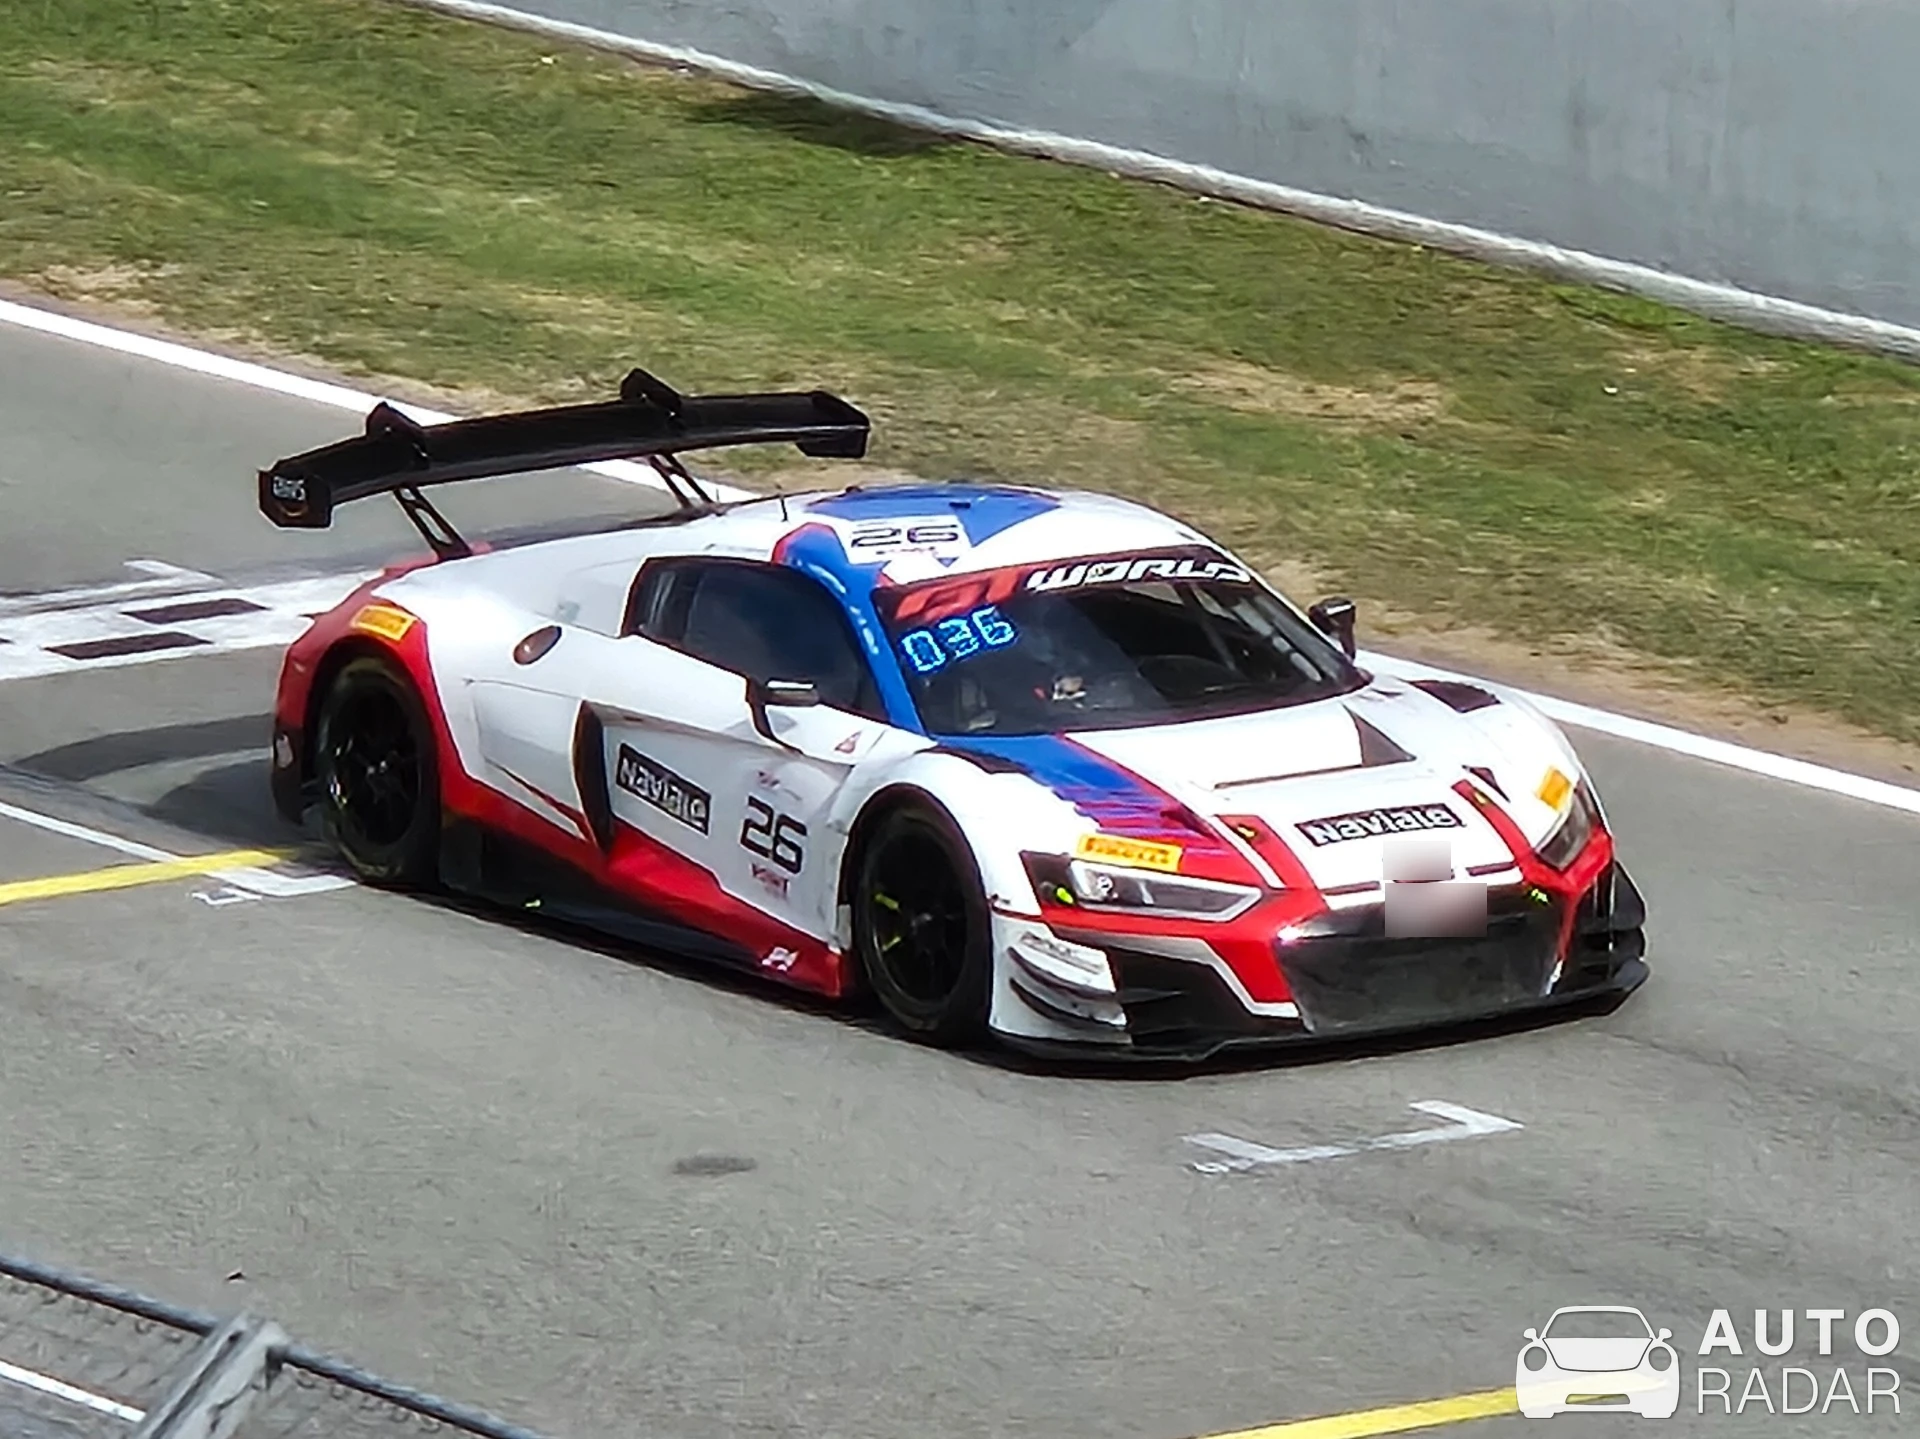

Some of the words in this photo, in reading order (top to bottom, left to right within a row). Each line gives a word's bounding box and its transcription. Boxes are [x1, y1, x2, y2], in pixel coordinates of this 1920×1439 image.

[851, 524, 959, 548] 26
[1026, 558, 1251, 591] WORLD
[901, 605, 1015, 672] 036
[740, 795, 808, 874] 26
